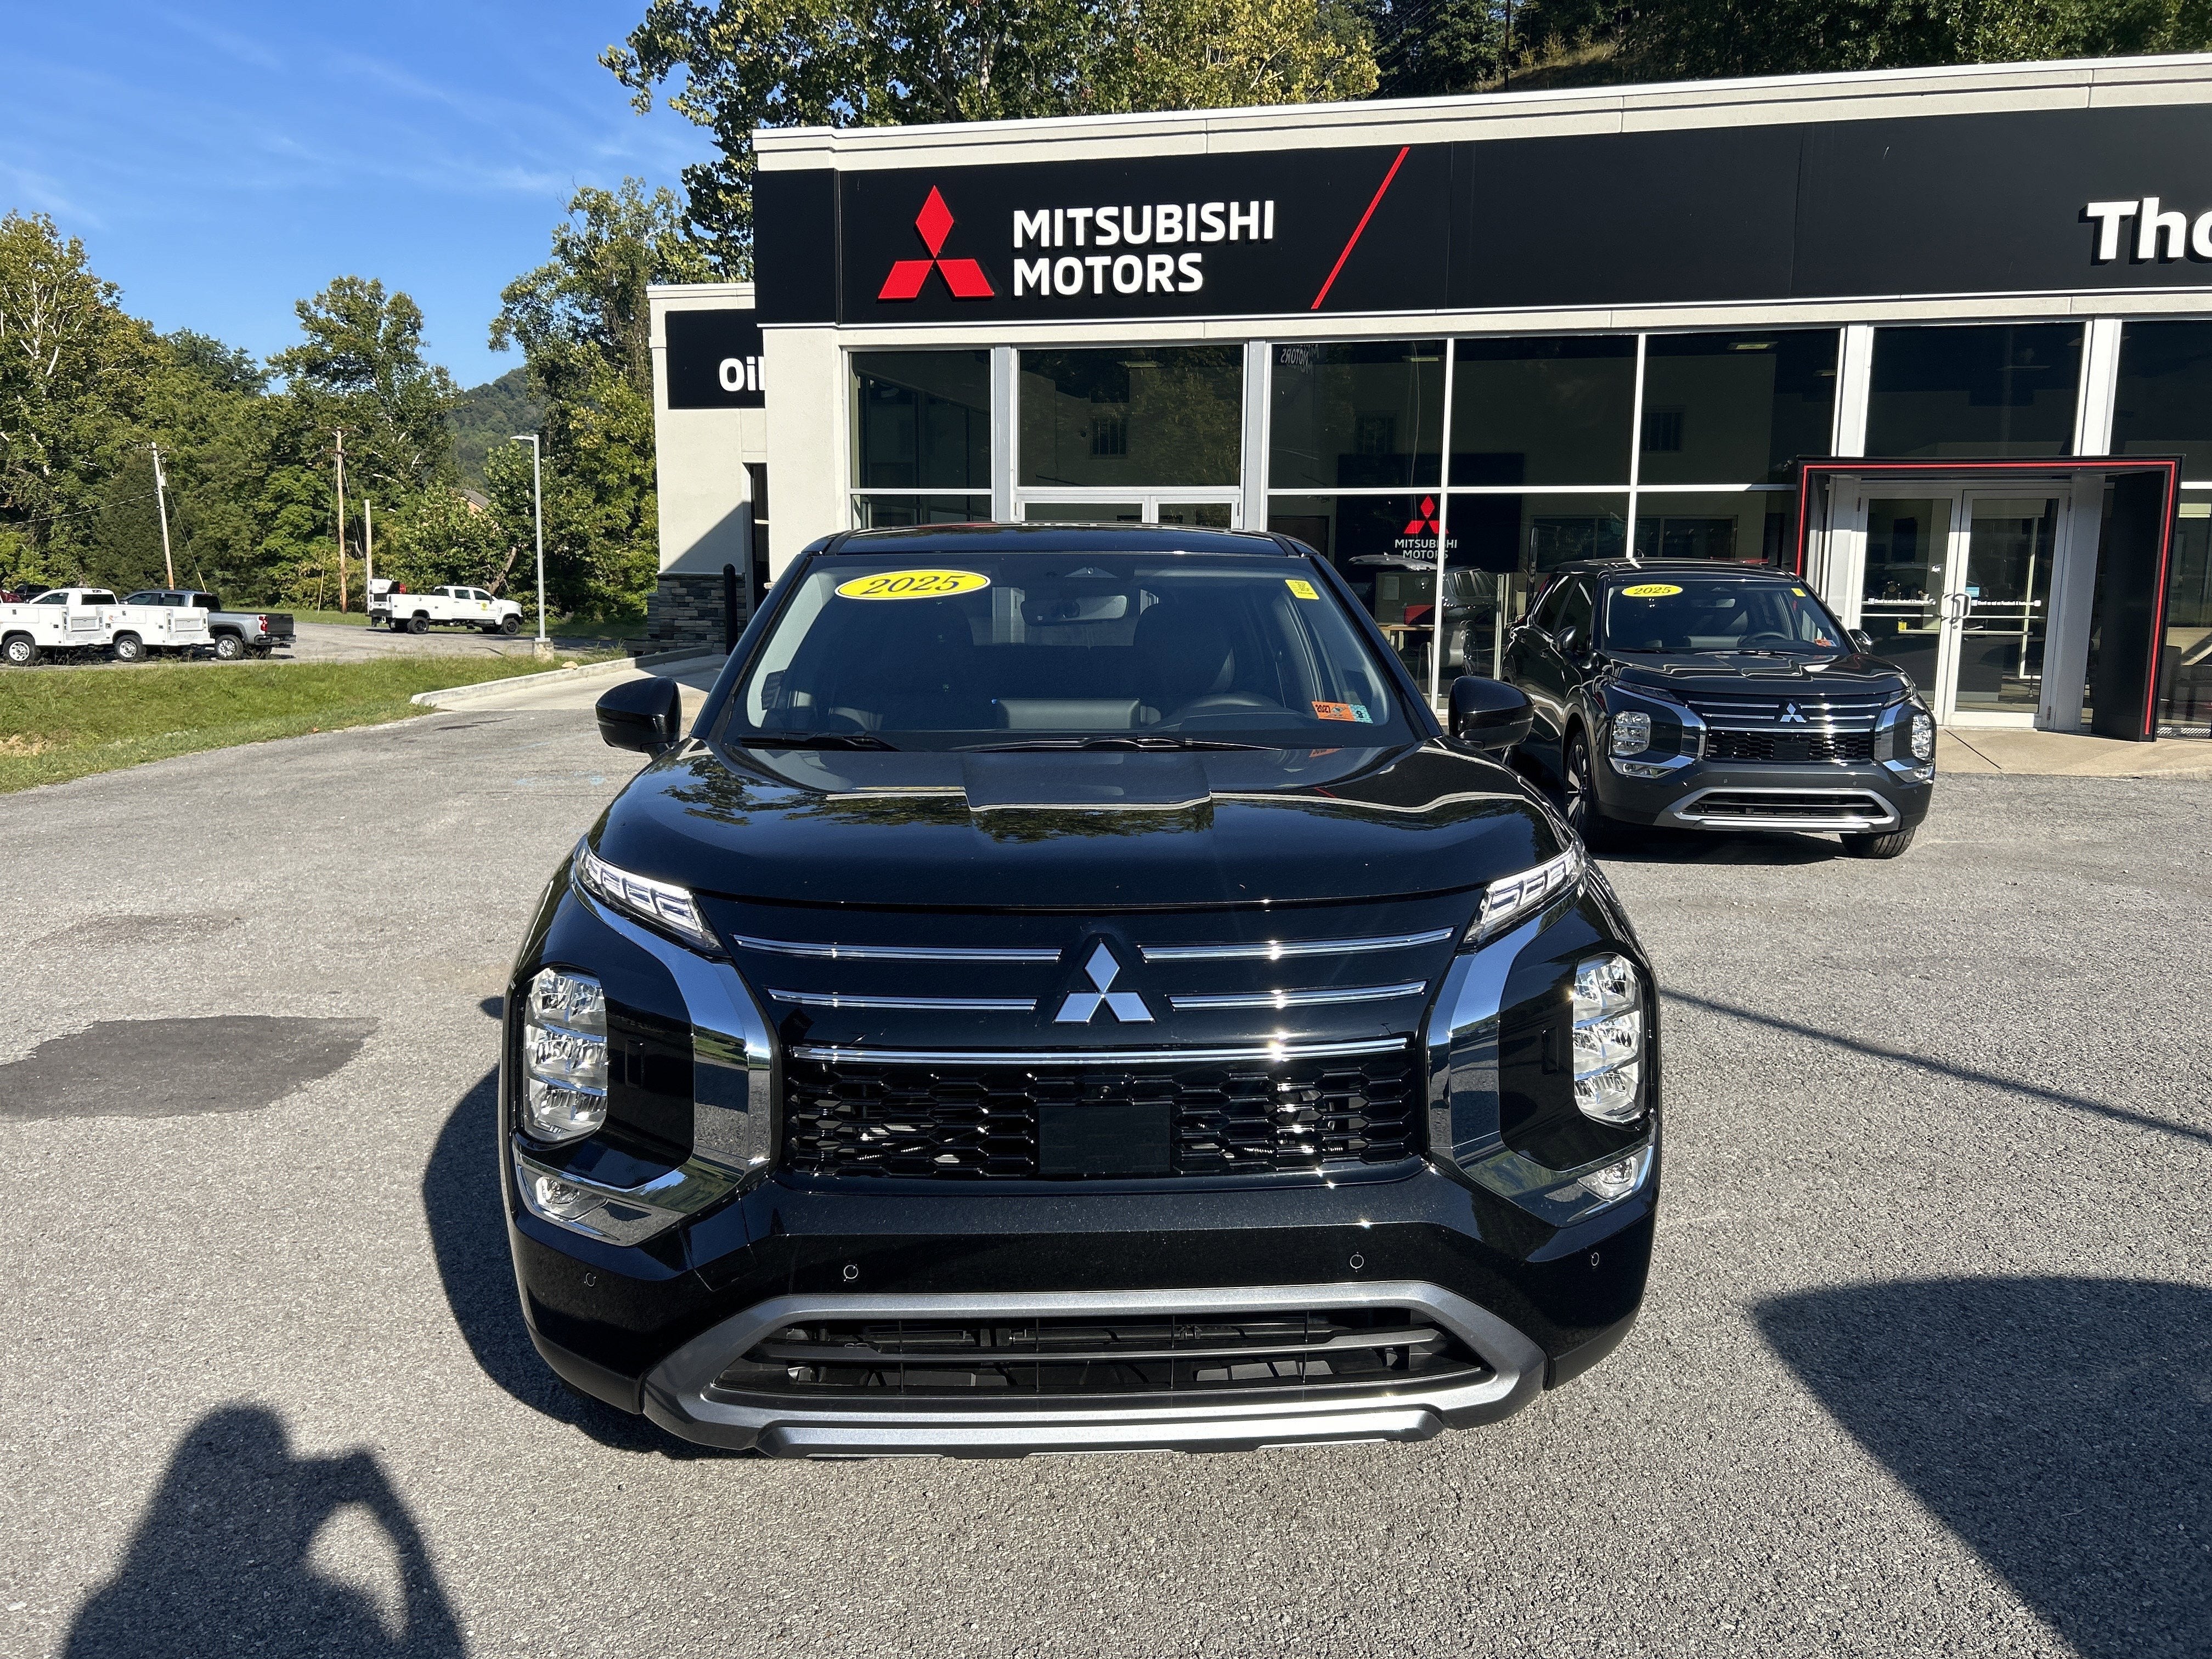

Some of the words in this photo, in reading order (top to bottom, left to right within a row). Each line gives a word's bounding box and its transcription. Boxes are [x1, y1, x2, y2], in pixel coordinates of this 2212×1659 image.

[1014, 200, 1274, 248] MITSUBISHI
[1014, 252, 1204, 296] MOTORS
[719, 356, 765, 392] Oil
[1395, 539, 1458, 549] MITSUBIHI
[859, 575, 967, 596] 2025
[1633, 586, 1672, 595] 2025
